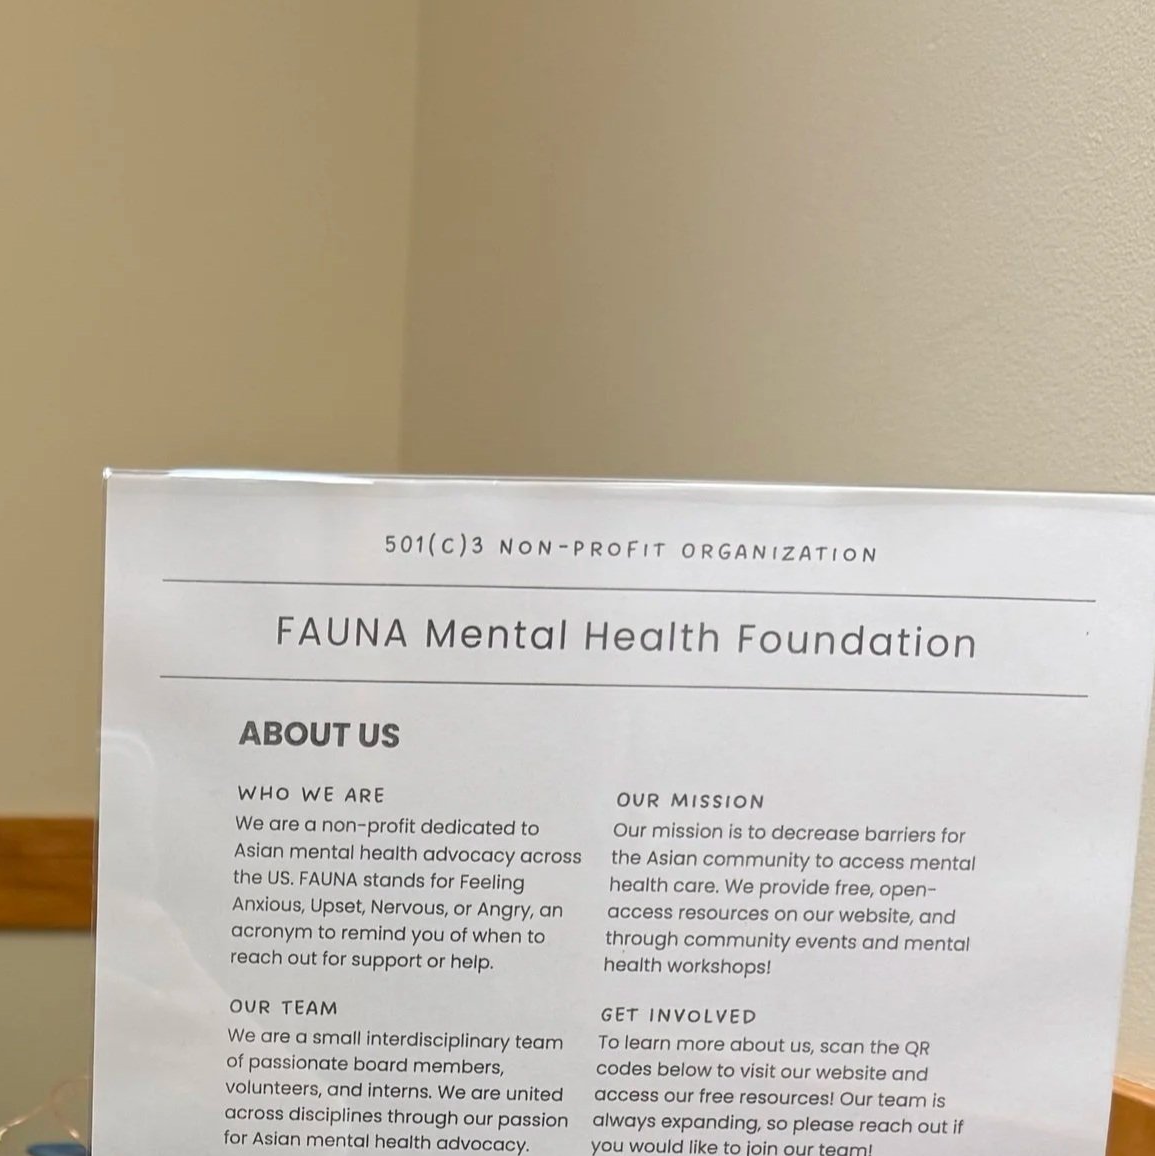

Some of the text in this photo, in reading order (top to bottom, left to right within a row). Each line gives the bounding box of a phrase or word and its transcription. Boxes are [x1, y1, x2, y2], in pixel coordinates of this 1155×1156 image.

[385, 531, 877, 563] 501(C)3 NON-PROFIT ORGANIZATION
[277, 615, 976, 659] FAUNA Mental Health Foundation
[238, 720, 400, 749] ABOUT US
[237, 784, 385, 804] WHO WE ARE
[616, 791, 764, 810] OUR MISSION
[235, 815, 540, 838] We are a non-profit dedicated to
[613, 821, 967, 844] Our mission is to decrease barriers for
[233, 841, 582, 868] Asian mental health advocacy across
[611, 848, 976, 873] the Asian community to access mental
[233, 868, 525, 896] the US. FAUNA stands for Feeling
[609, 875, 669, 893] health
[673, 880, 720, 894] care.
[724, 878, 755, 895] We
[758, 878, 830, 900] provide
[835, 878, 875, 899] free,
[231, 895, 563, 922] Anxious, Upset, Nervous, or Angry, an
[603, 956, 772, 979] health workshops!
[229, 998, 338, 1017] OUR TEAM
[600, 1006, 757, 1025] GET INVOLVED
[227, 1027, 564, 1054] We are a small interdisciplinary team
[597, 1034, 931, 1058] To learn more about us, scan the QR
[226, 1052, 505, 1078] of passionate board members,
[596, 1060, 929, 1082] codes below to visit our website and
[225, 1078, 564, 1103] volunteers, and interns. We are united
[592, 1111, 965, 1136] always expanding, so please reach out if
[590, 1140, 624, 1156] you
[628, 1138, 684, 1155] would
[688, 1139, 719, 1156] like
[723, 1140, 742, 1156] to
[783, 1144, 815, 1156] our
